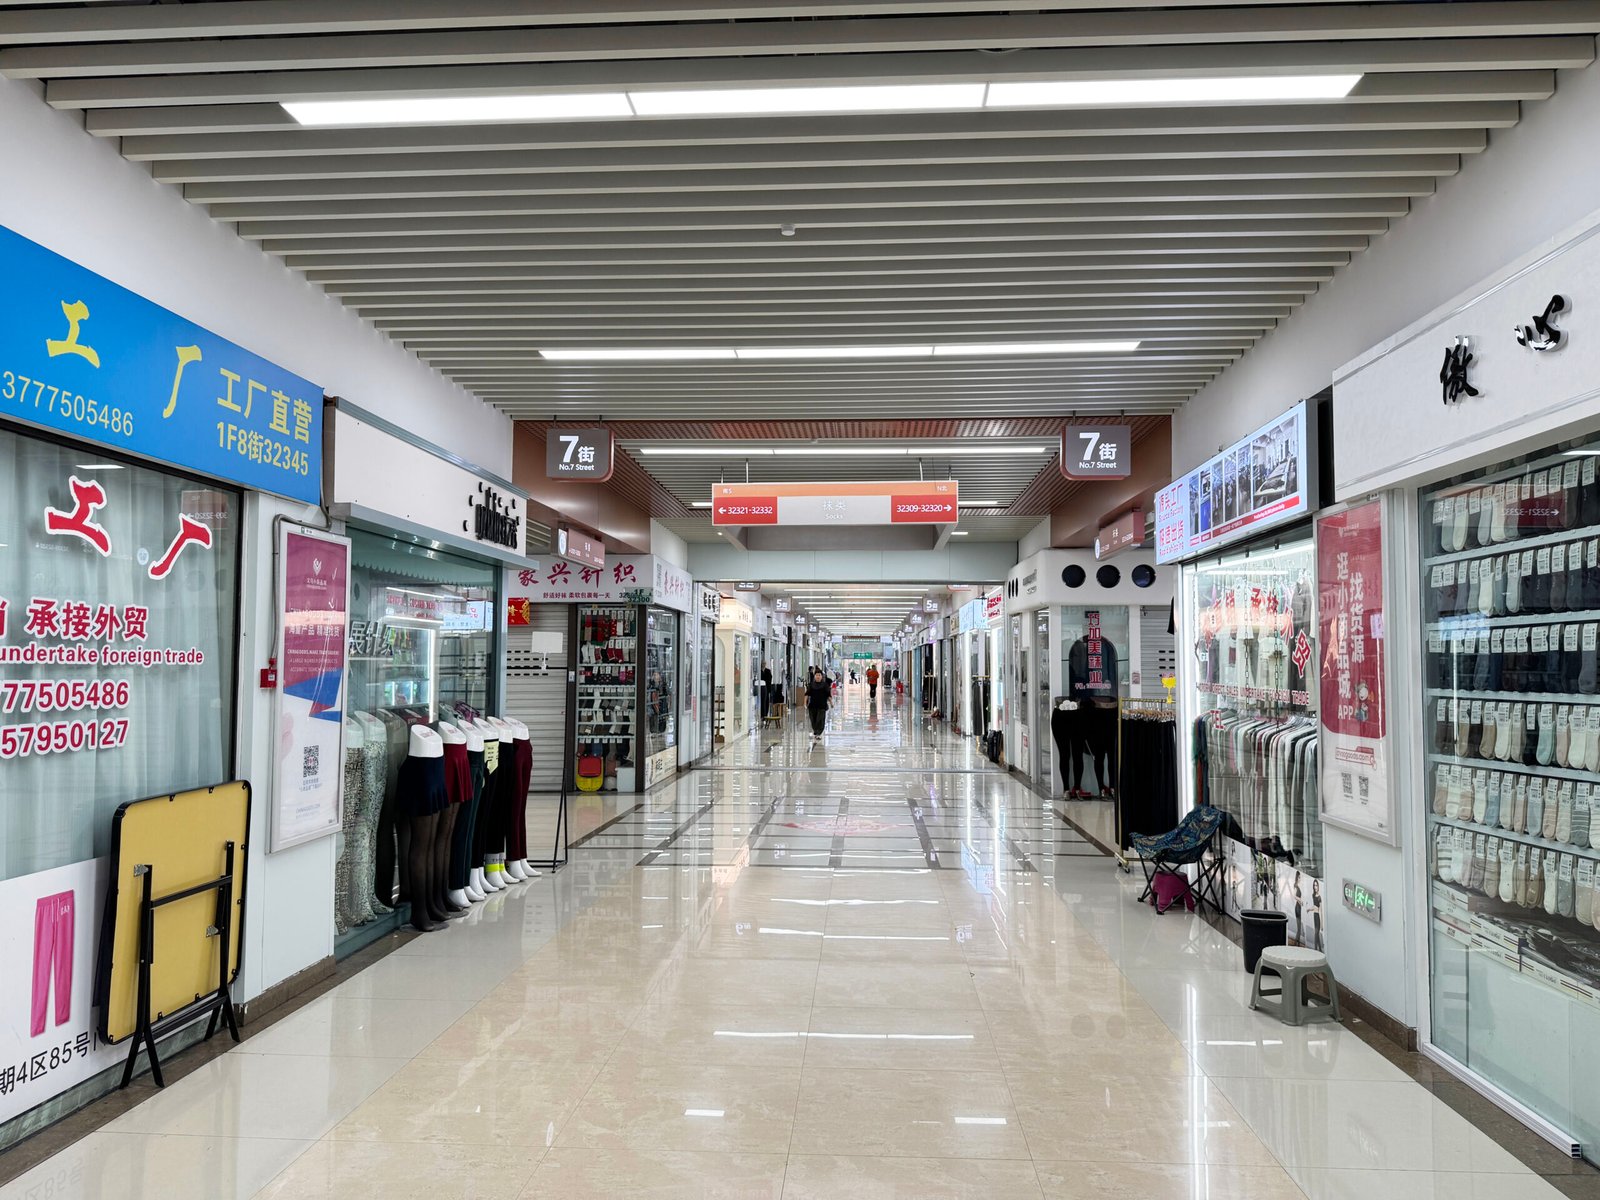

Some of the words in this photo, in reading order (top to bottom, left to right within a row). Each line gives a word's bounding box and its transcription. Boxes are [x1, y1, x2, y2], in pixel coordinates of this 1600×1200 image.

[217, 367, 312, 444] 工厂直营
[217, 422, 309, 476] 1F8街32345
[559, 435, 595, 463] 7街
[1079, 432, 1117, 461] 7街
[1079, 461, 1095, 469] No.7
[1096, 461, 1117, 469] Street
[727, 505, 773, 515] 32321-32332
[825, 512, 844, 520] Socks
[896, 503, 943, 513] 32309-32320
[518, 561, 637, 589] 家兴针织
[25, 598, 148, 642] 承接外贸
[1350, 572, 1365, 664] 找货源
[102, 647, 163, 667] foreign
[165, 648, 204, 665] trade
[3, 681, 129, 712] 77505486
[1338, 704, 1353, 720] APP
[1, 719, 129, 757] 57950127
